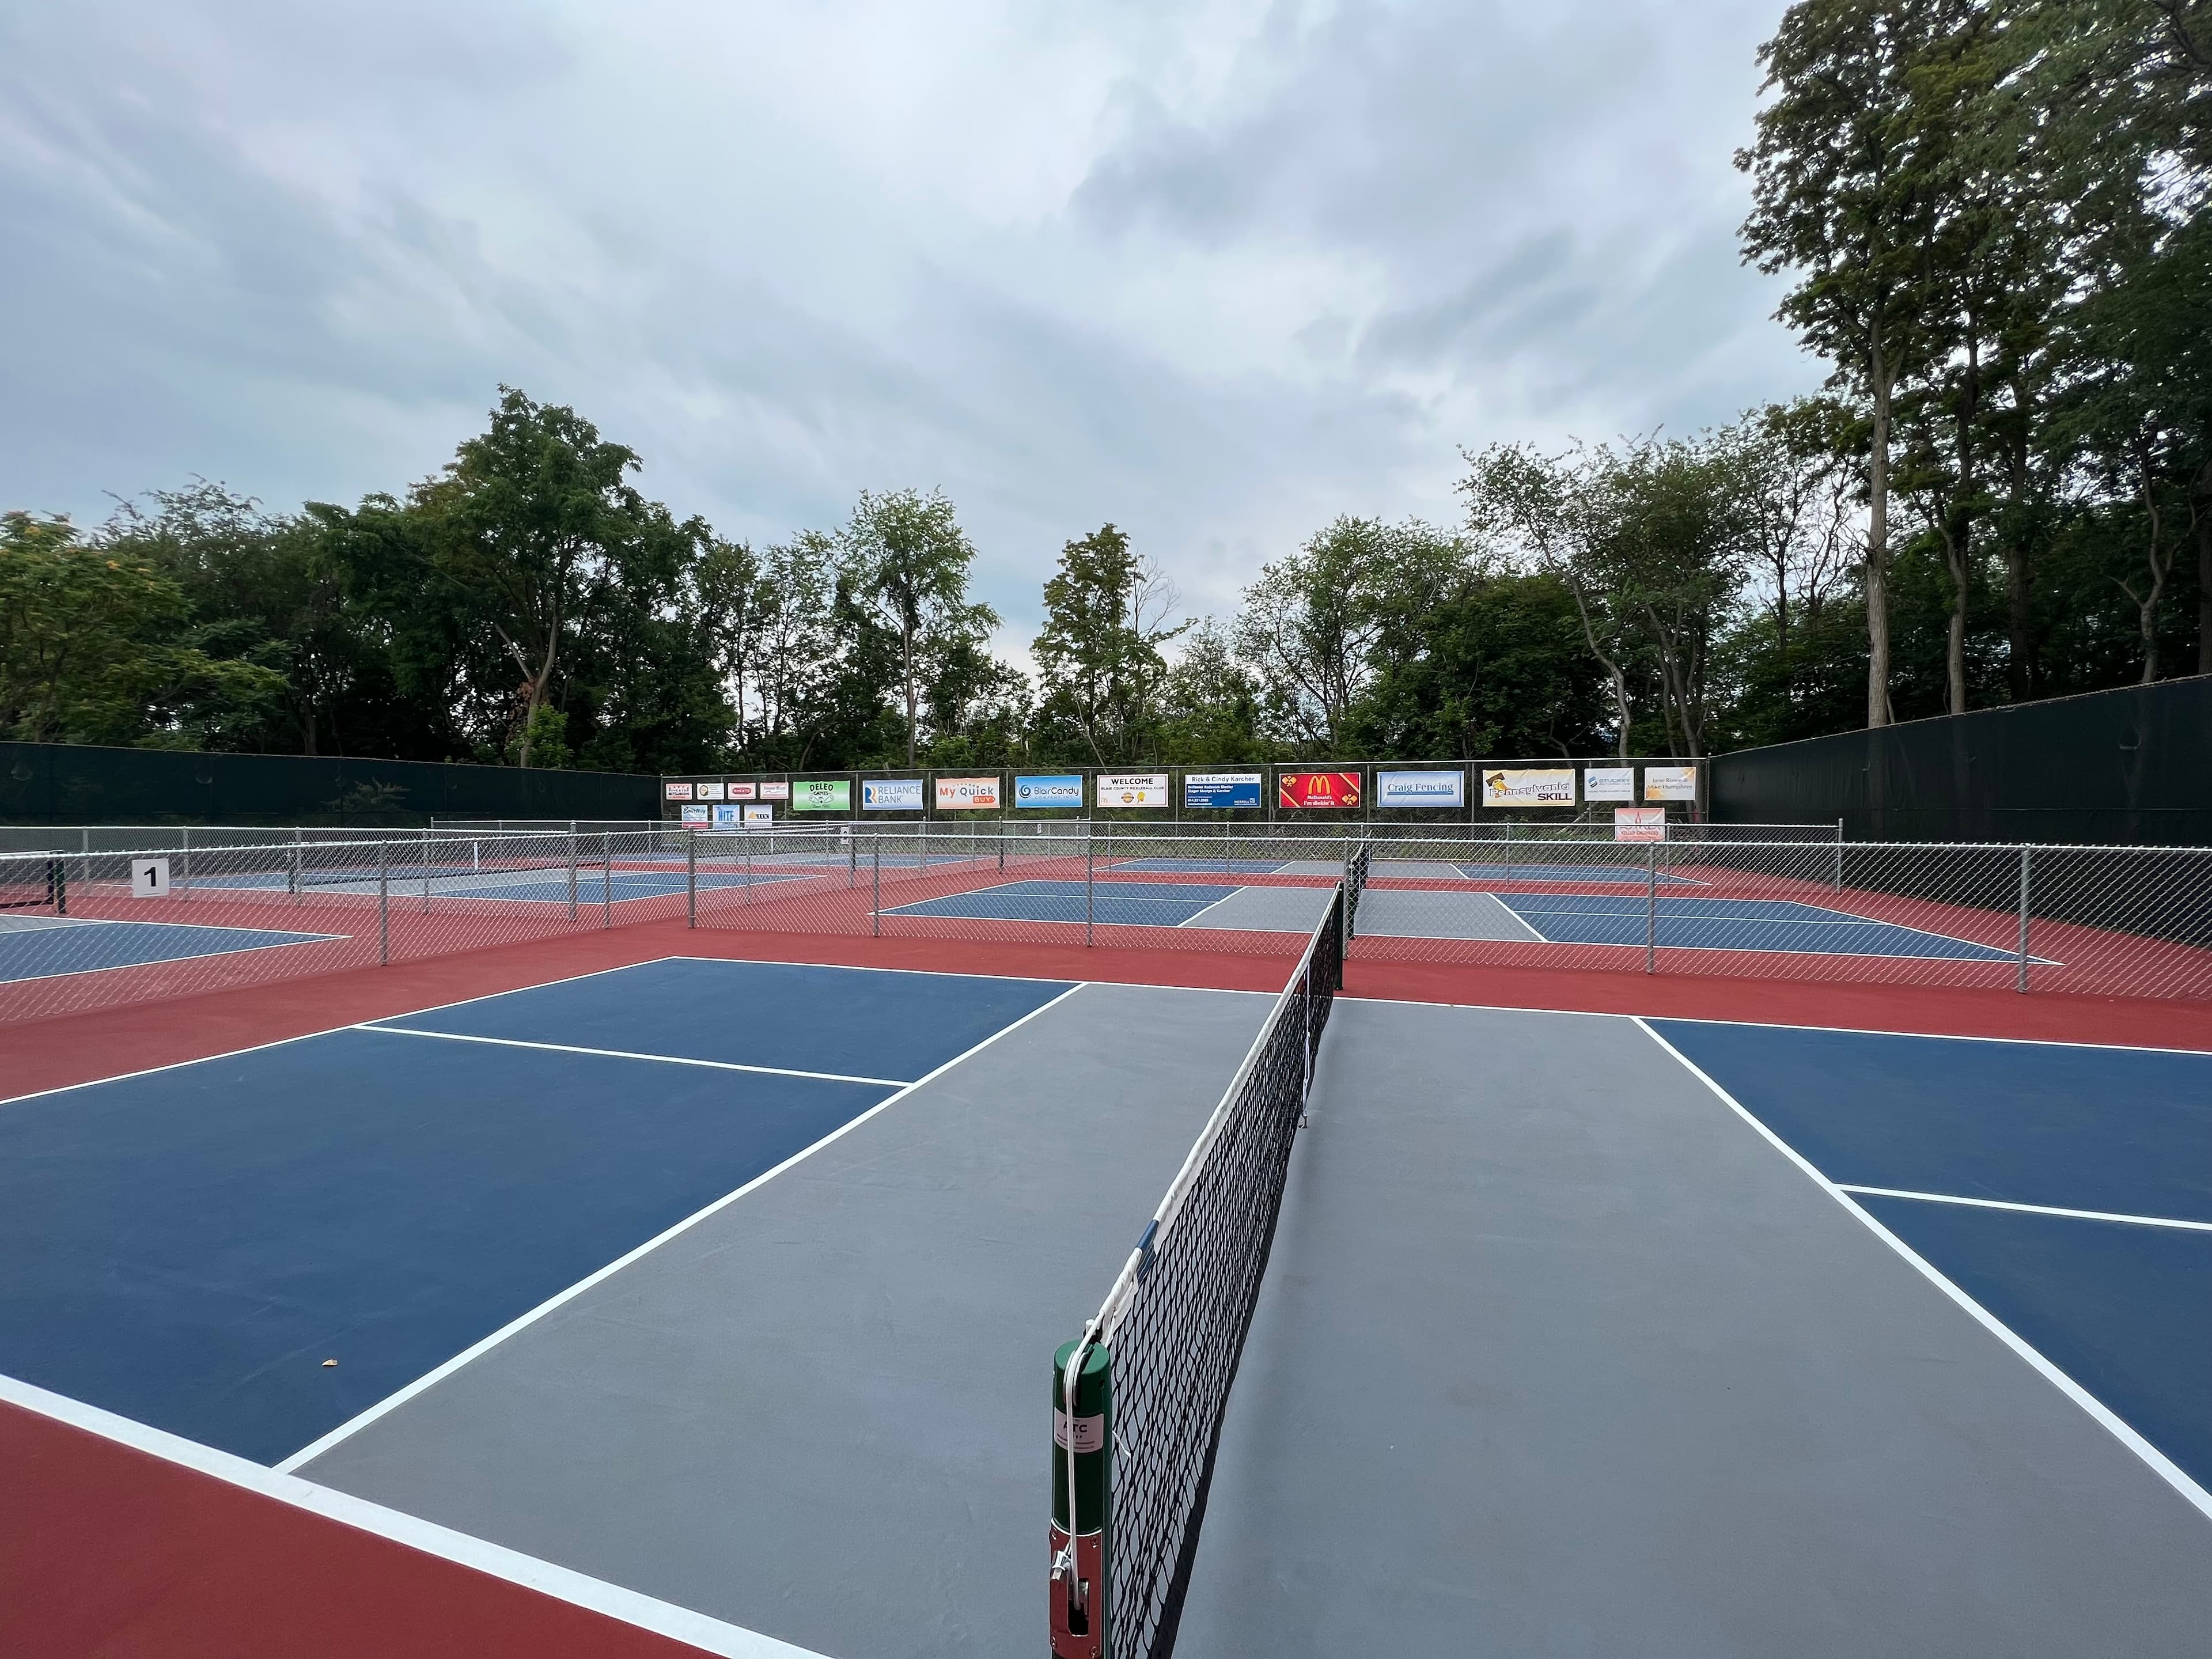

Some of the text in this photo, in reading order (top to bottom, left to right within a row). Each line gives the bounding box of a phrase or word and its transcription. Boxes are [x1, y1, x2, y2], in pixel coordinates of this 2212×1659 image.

[809, 783, 834, 791] DELEO
[878, 786, 921, 794] RELIANCE
[940, 786, 994, 798] My Quick
[1388, 783, 1453, 793] Craig Fencing
[1490, 782, 1570, 797] Pennsylvania
[878, 796, 902, 804] BANK
[143, 866, 156, 887] 1
